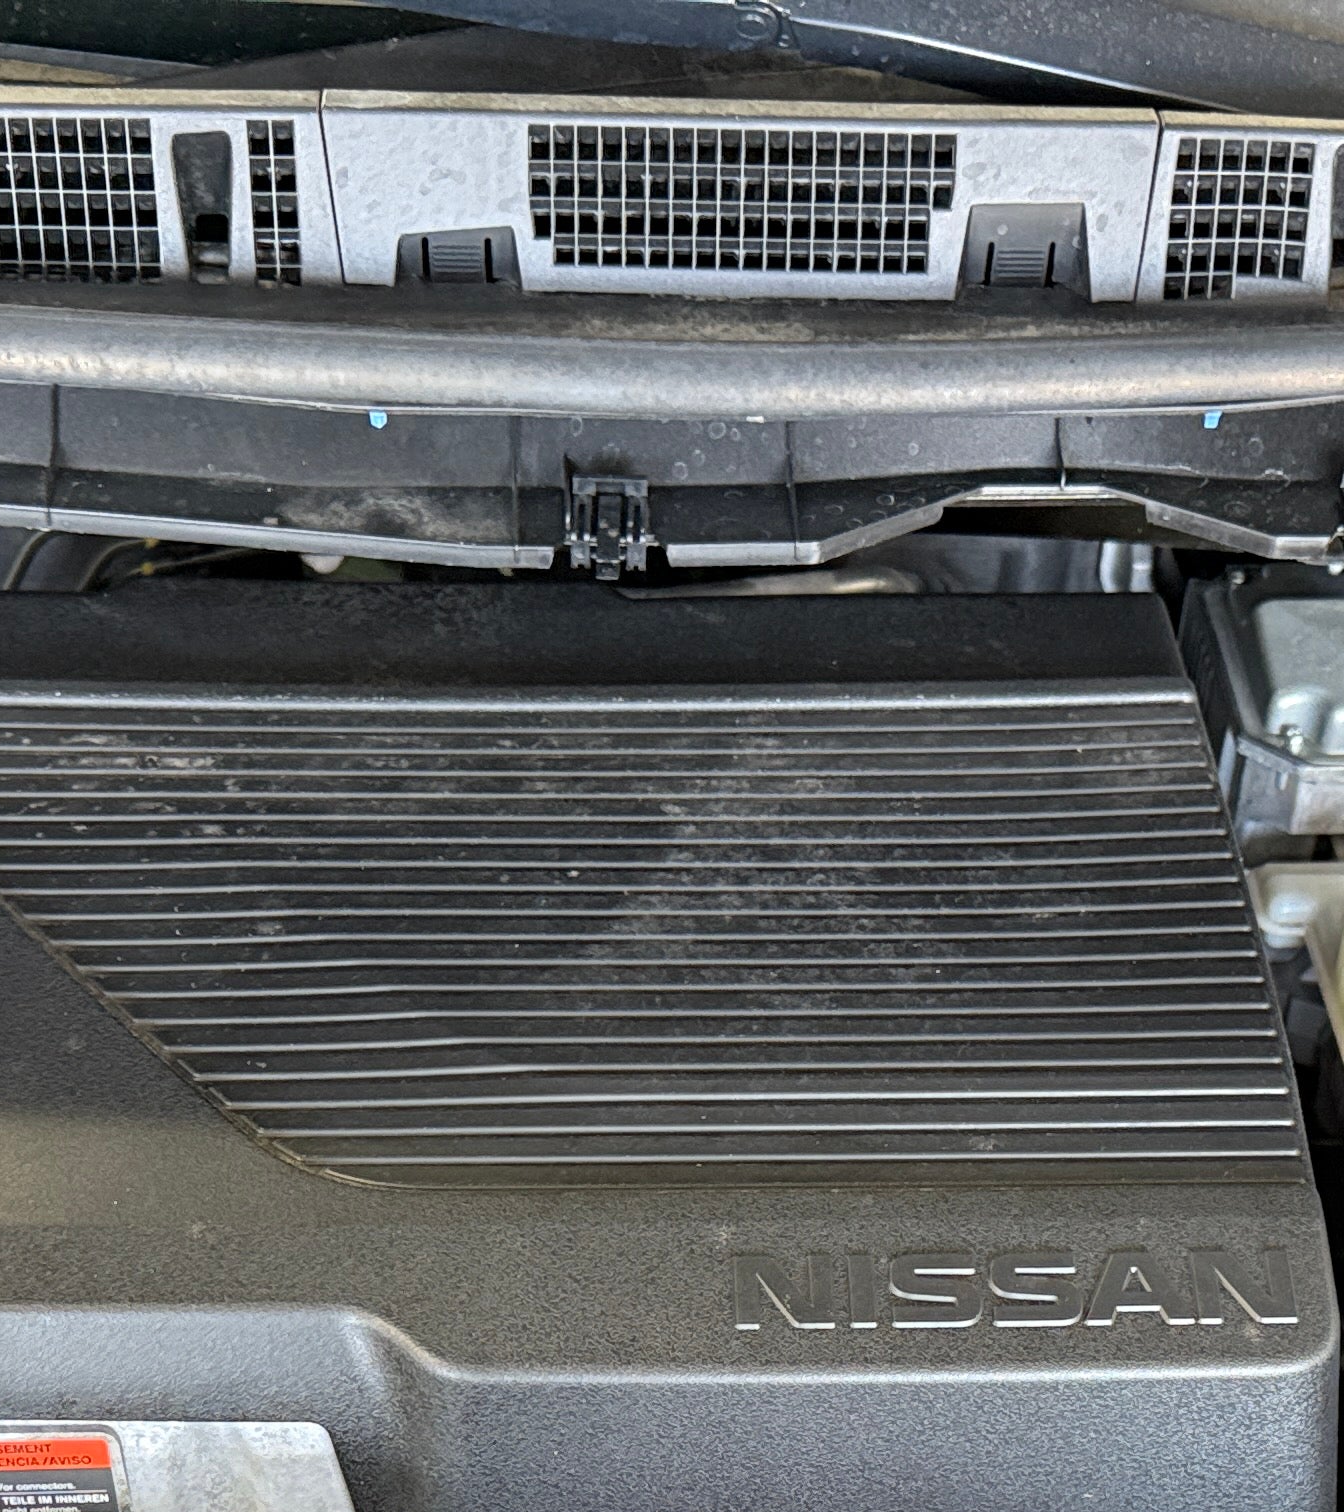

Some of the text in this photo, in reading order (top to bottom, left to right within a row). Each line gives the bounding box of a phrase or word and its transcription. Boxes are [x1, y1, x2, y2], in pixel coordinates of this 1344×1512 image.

[735, 1249, 1298, 1331] NISSAN
[0, 1495, 36, 1506] TEILE
[38, 1495, 53, 1505] IM
[54, 1493, 110, 1504] INNEREN
